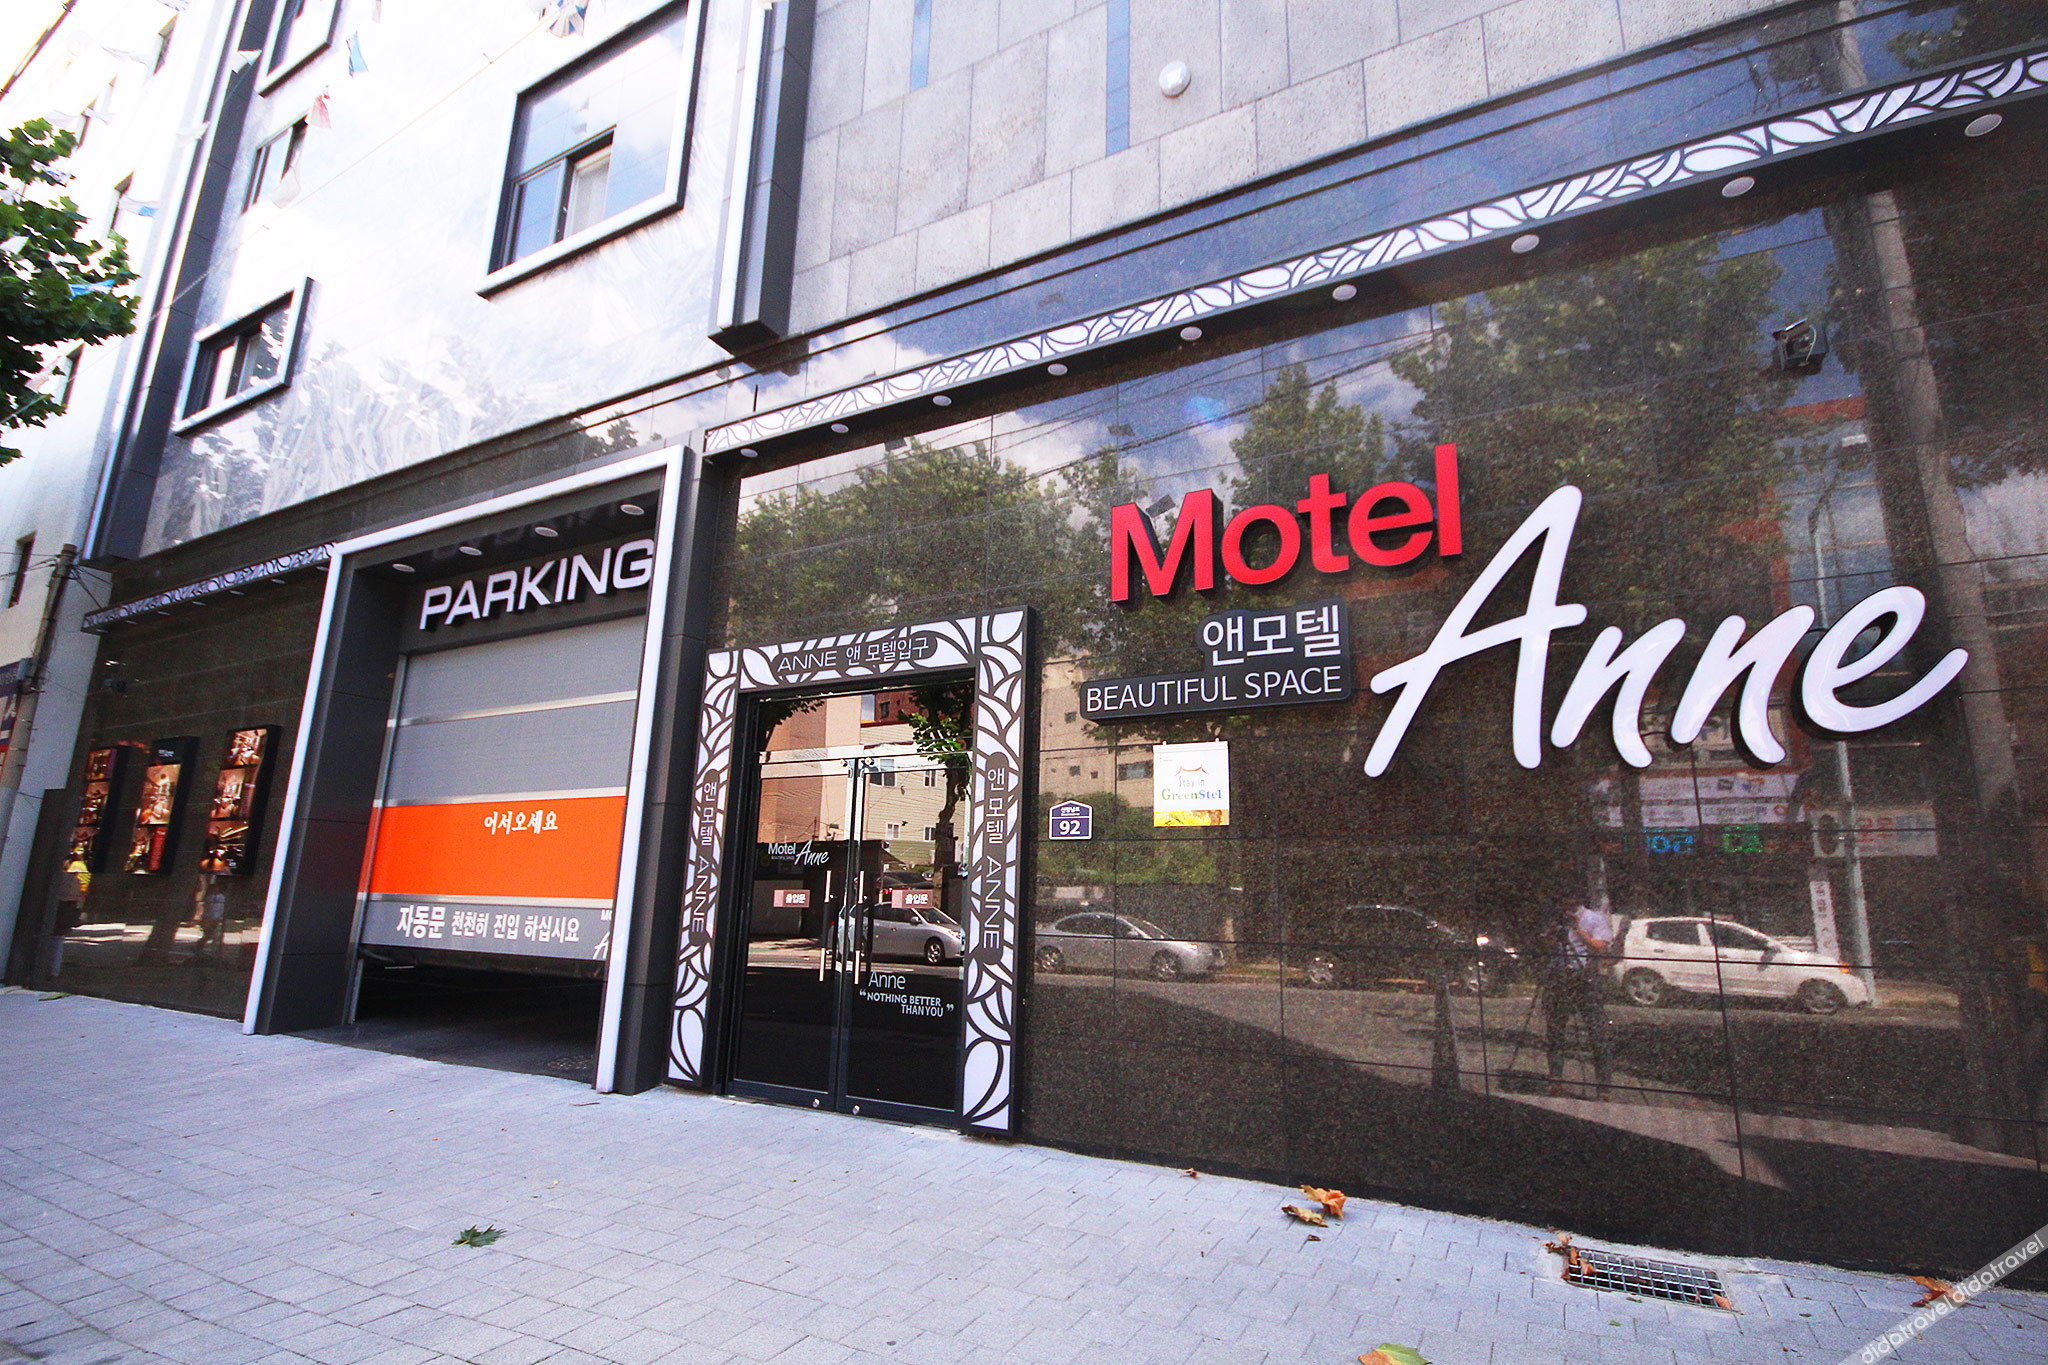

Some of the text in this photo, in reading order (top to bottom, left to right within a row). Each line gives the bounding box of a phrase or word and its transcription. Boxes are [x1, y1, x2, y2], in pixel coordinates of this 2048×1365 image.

[1111, 442, 1463, 602] Motel
[419, 538, 654, 630] PARKING
[1202, 604, 1342, 666] 앤모텔
[1364, 485, 1969, 778] Anne
[777, 637, 929, 673] ANNE 앤 모텔입구
[1086, 665, 1343, 713] BEAUTIFUL SPACE
[1161, 788, 1222, 801] GreenStel
[483, 810, 558, 835] 어서오세요
[1059, 820, 1081, 835] 92
[768, 839, 830, 866] Motel Anne
[691, 855, 710, 933] ANNE
[983, 855, 1002, 949] ANNE
[396, 904, 446, 939] 자동문
[451, 910, 489, 937] 천천히
[493, 913, 520, 940] 진입
[868, 971, 906, 990] Anne
[909, 995, 942, 1007] BETTER
